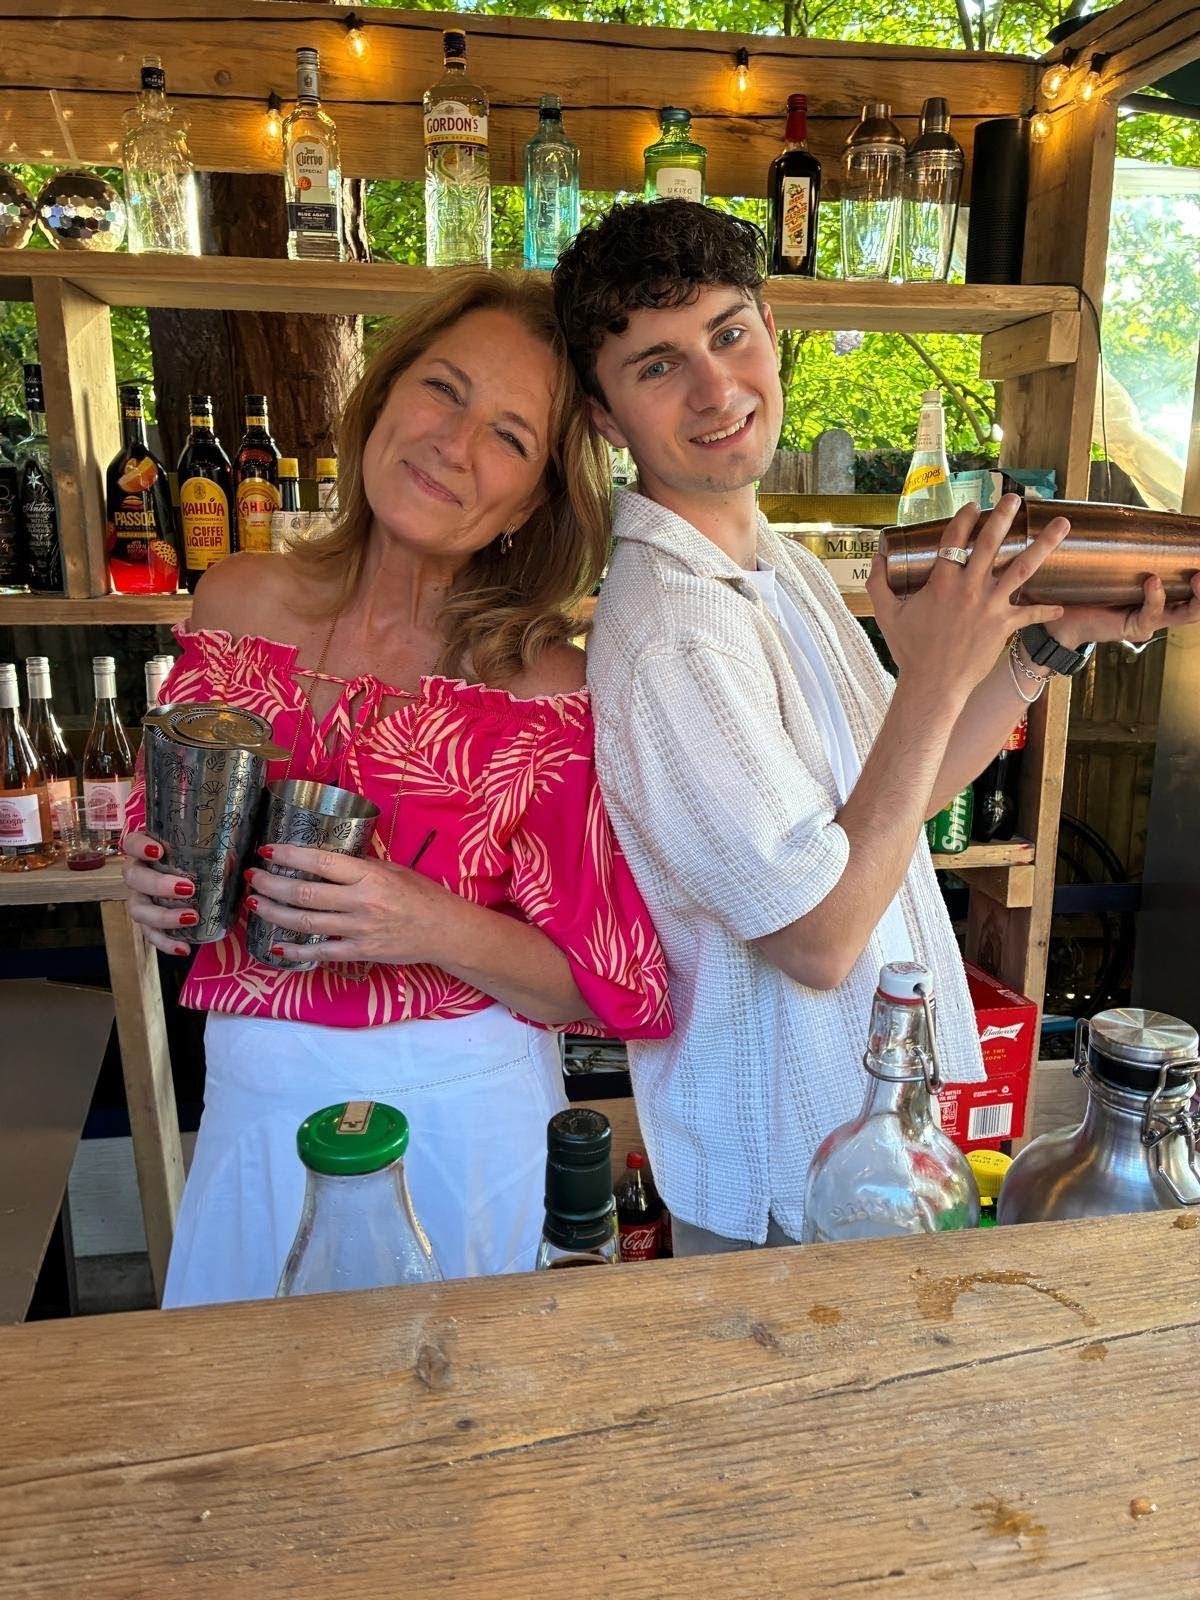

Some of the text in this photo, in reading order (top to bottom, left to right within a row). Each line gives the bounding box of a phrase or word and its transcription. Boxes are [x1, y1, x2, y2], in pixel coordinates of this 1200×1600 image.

[426, 116, 479, 134] GORDON'S
[296, 151, 323, 167] Cuervo
[667, 187, 693, 195] UKIYO
[182, 497, 225, 517] KAHLÚA
[192, 526, 224, 537] COFFEE
[187, 536, 222, 547] LIQUEUR
[827, 539, 878, 552] MULBE
[983, 1027, 1018, 1037] Budweiser
